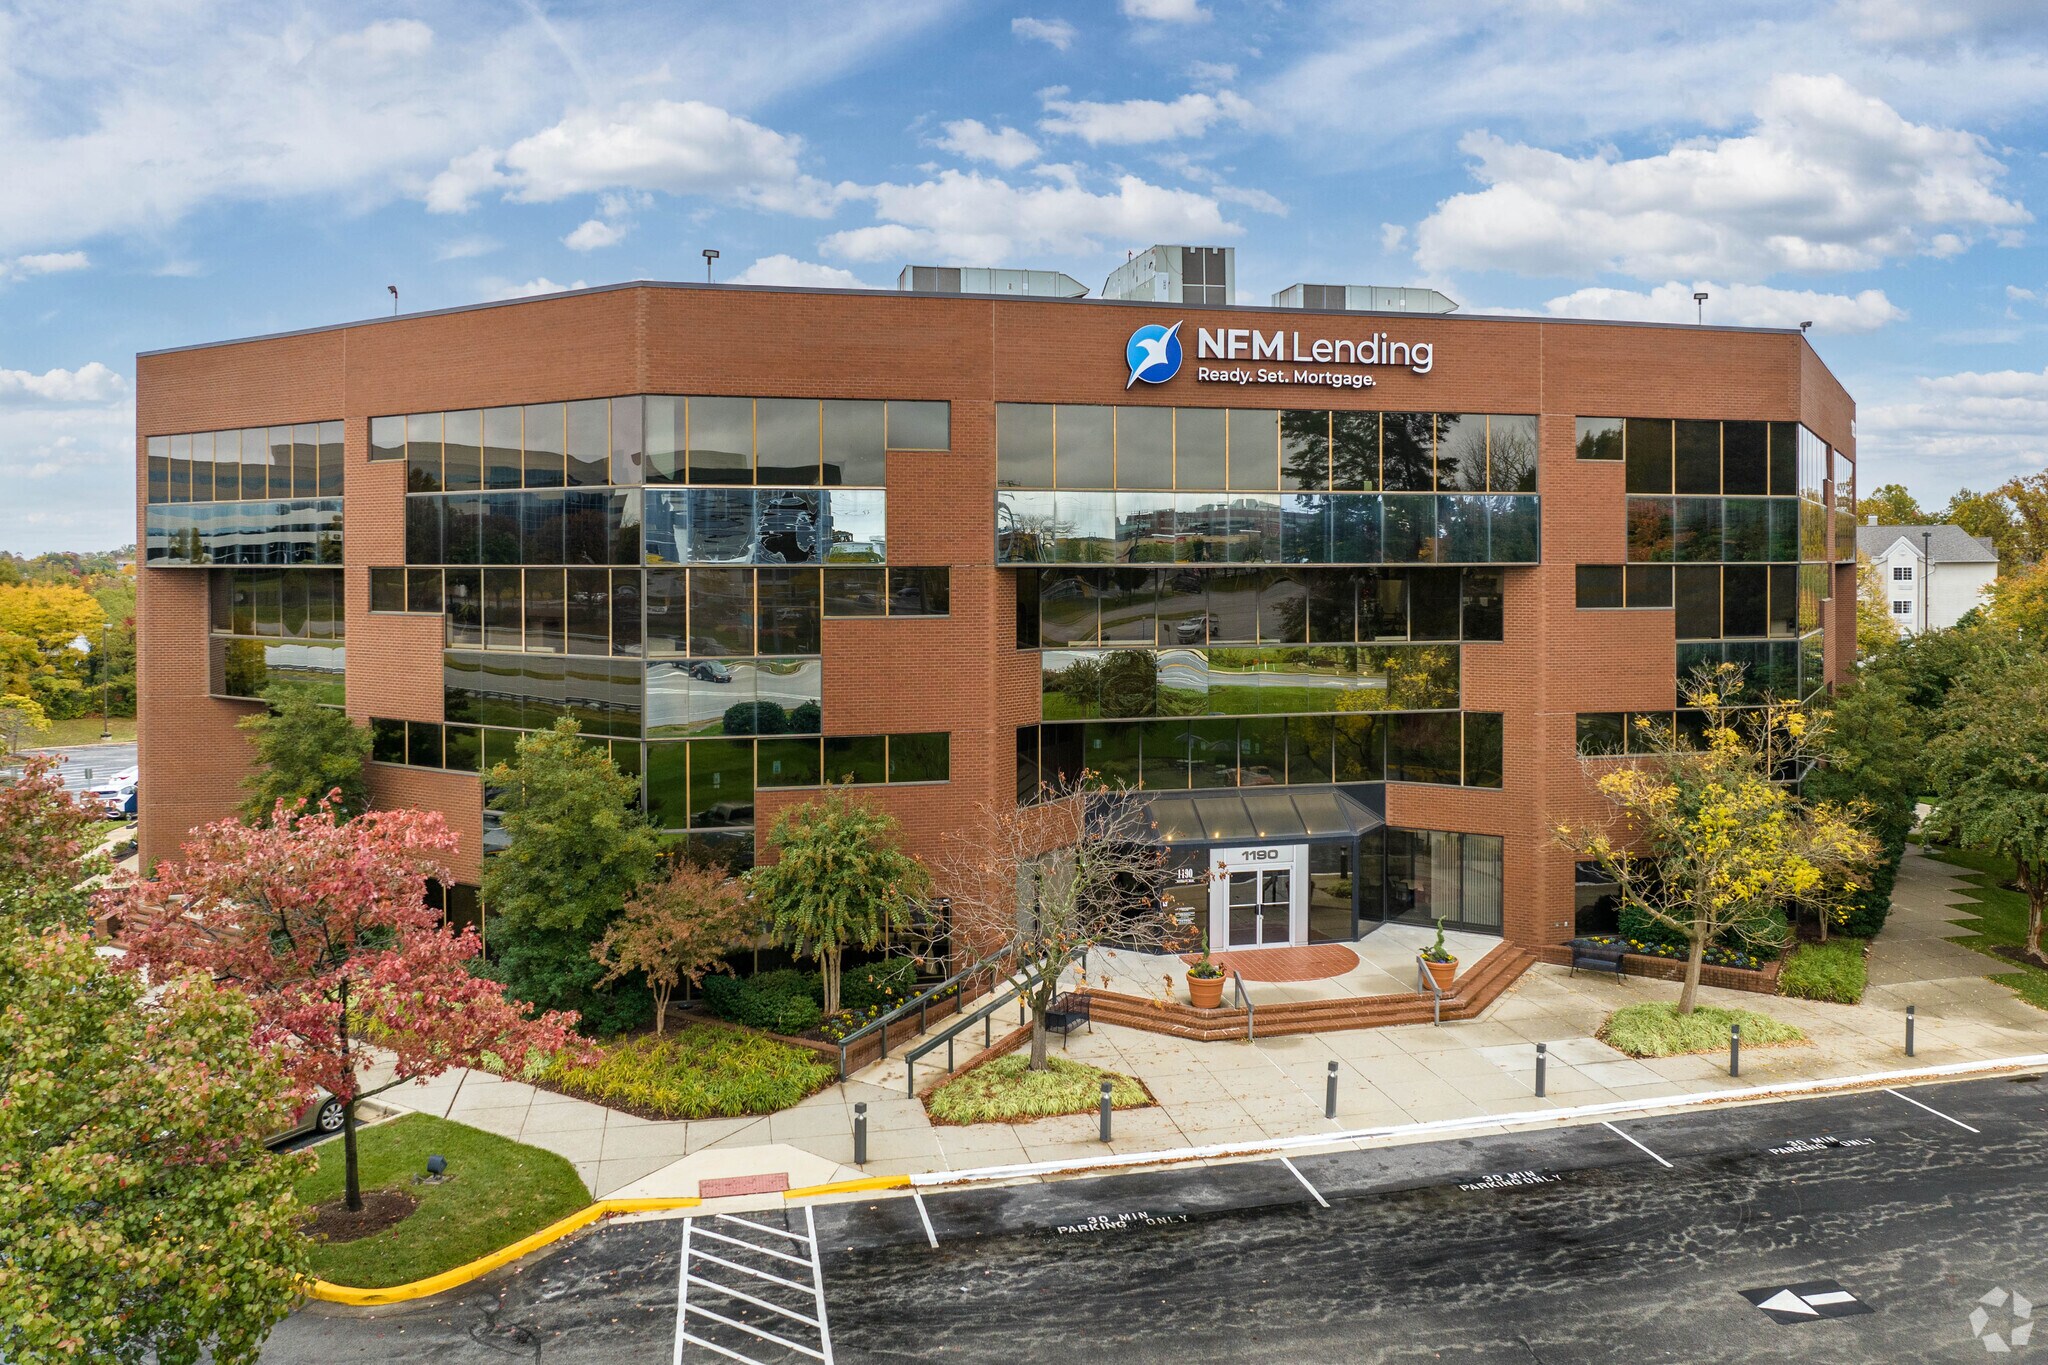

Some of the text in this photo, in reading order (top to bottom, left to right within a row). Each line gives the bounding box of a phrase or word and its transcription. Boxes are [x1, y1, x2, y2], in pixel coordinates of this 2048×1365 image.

[1197, 327, 1434, 374] NFM Lending
[1198, 367, 1377, 388] Ready. Set. Mortgage.
[1242, 849, 1278, 860] 1190
[1769, 1137, 1876, 1154] PARKING ONLY
[1786, 1135, 1839, 1147] 30 MIN
[1459, 1174, 1562, 1191] PARKING ONLY
[1482, 1170, 1536, 1182] 30 MIN
[1057, 1214, 1188, 1234] PARKING ONLY
[1087, 1211, 1149, 1224] 30 MIN
